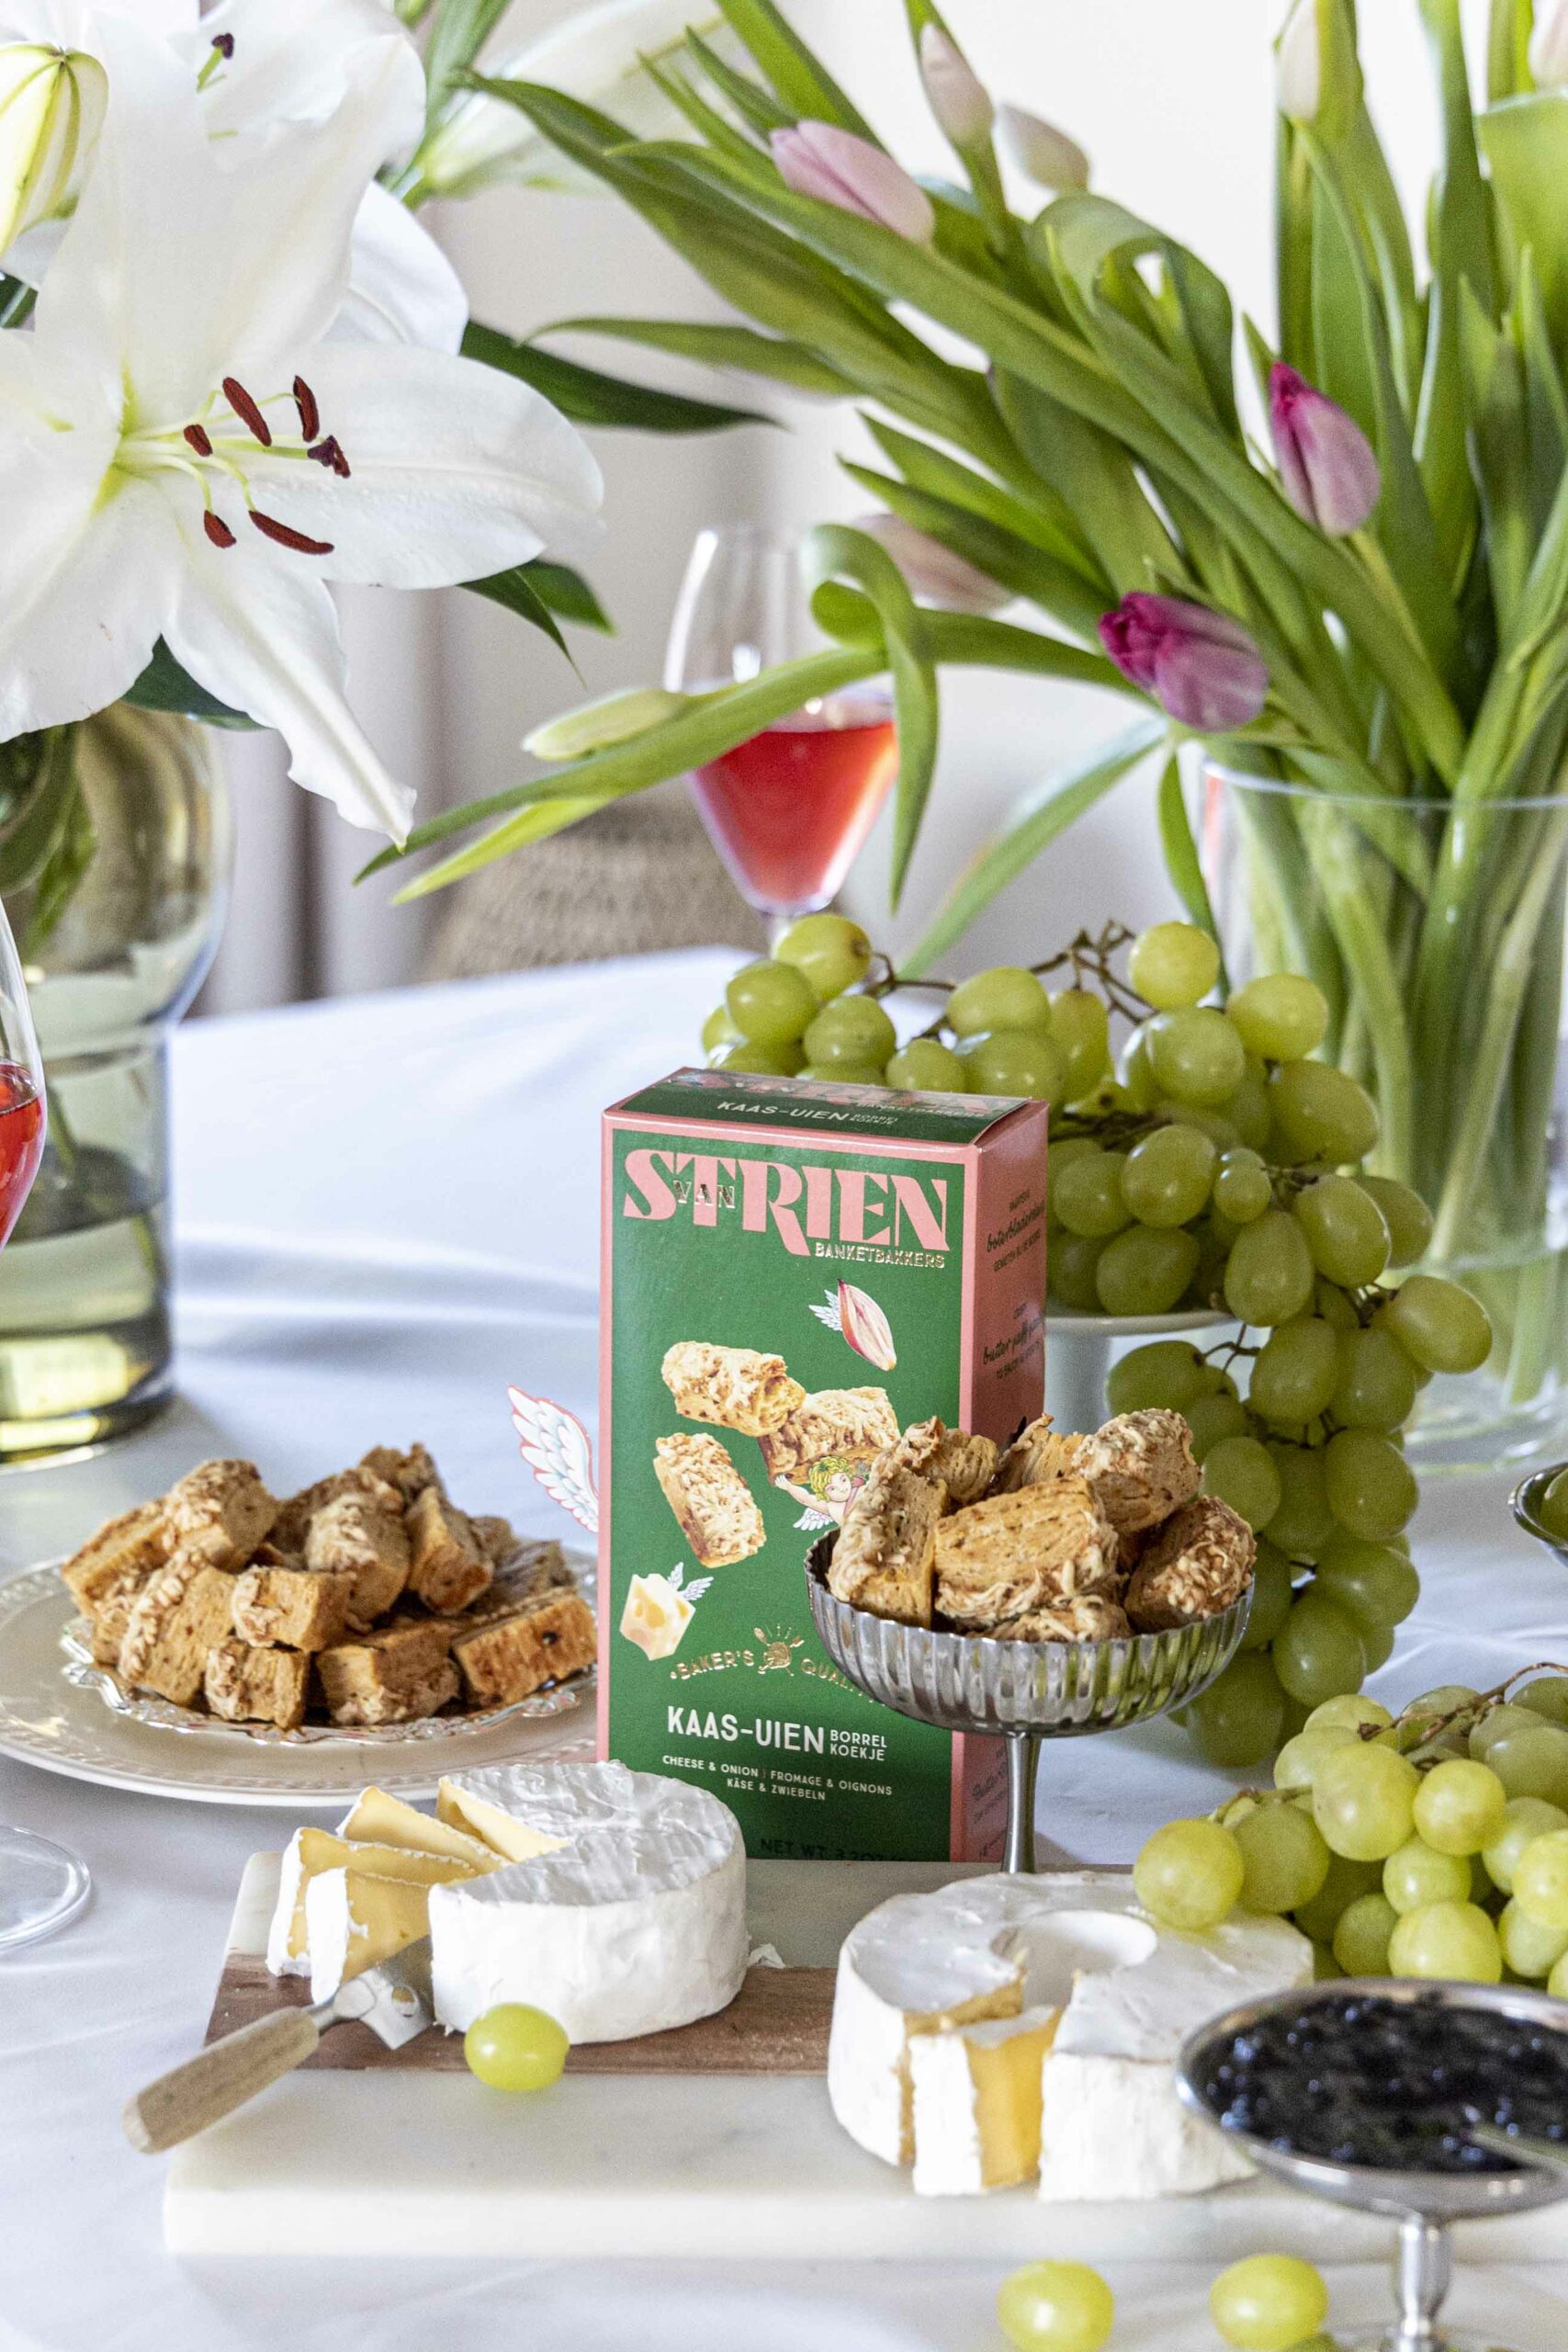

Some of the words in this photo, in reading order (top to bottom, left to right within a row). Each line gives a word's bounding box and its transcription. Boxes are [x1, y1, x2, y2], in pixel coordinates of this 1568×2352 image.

[716, 1101, 851, 1121] KAAS-UIEN
[624, 1148, 951, 1257] STRIEN
[672, 1180, 735, 1209] VAN
[815, 1242, 945, 1269] BANKETBAKKERS
[667, 1705, 824, 1755] KAAS-UIEN
[829, 1729, 887, 1748] BORREL
[829, 1744, 886, 1761] KOEKJE
[662, 1755, 705, 1770] CHEESE
[708, 1761, 716, 1771] &
[720, 1763, 759, 1778] ONION
[771, 1770, 822, 1786] FROMAGE
[826, 1778, 834, 1788] &
[839, 1780, 893, 1796] OIGNONS
[759, 1782, 767, 1792] &
[771, 1784, 826, 1801] ZWIEBELN
